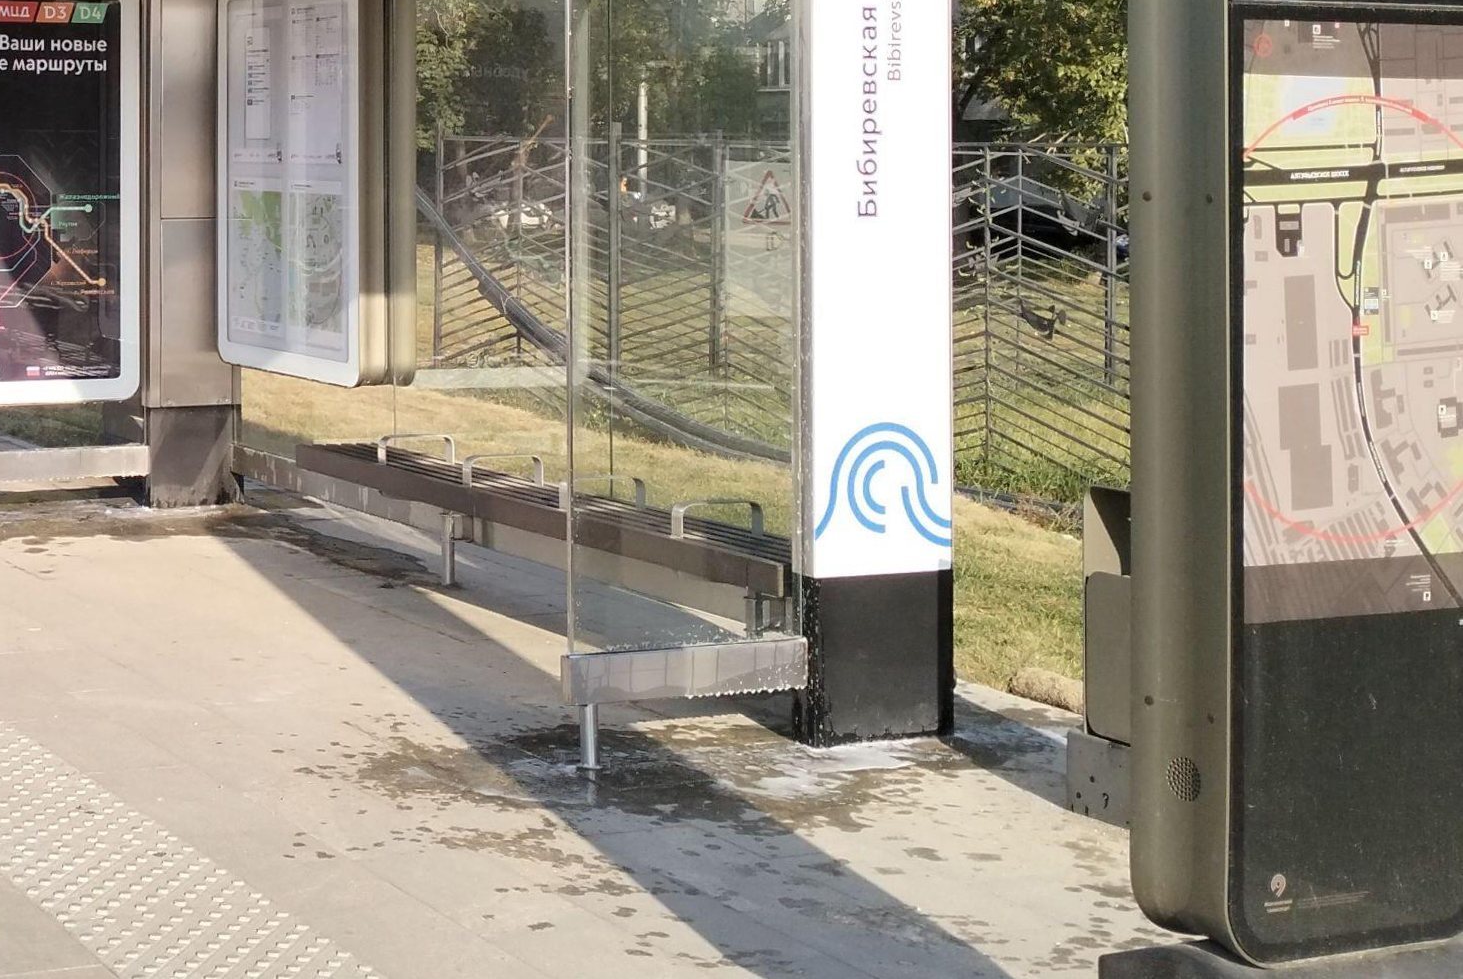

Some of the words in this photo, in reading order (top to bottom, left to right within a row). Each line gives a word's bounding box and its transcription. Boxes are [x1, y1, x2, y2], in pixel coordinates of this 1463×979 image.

[43, 5, 67, 19] D3
[79, 5, 102, 20] D4
[50, 38, 108, 52] новые
[12, 58, 107, 75] маршруты
[856, 5, 881, 218] Бибиревская
